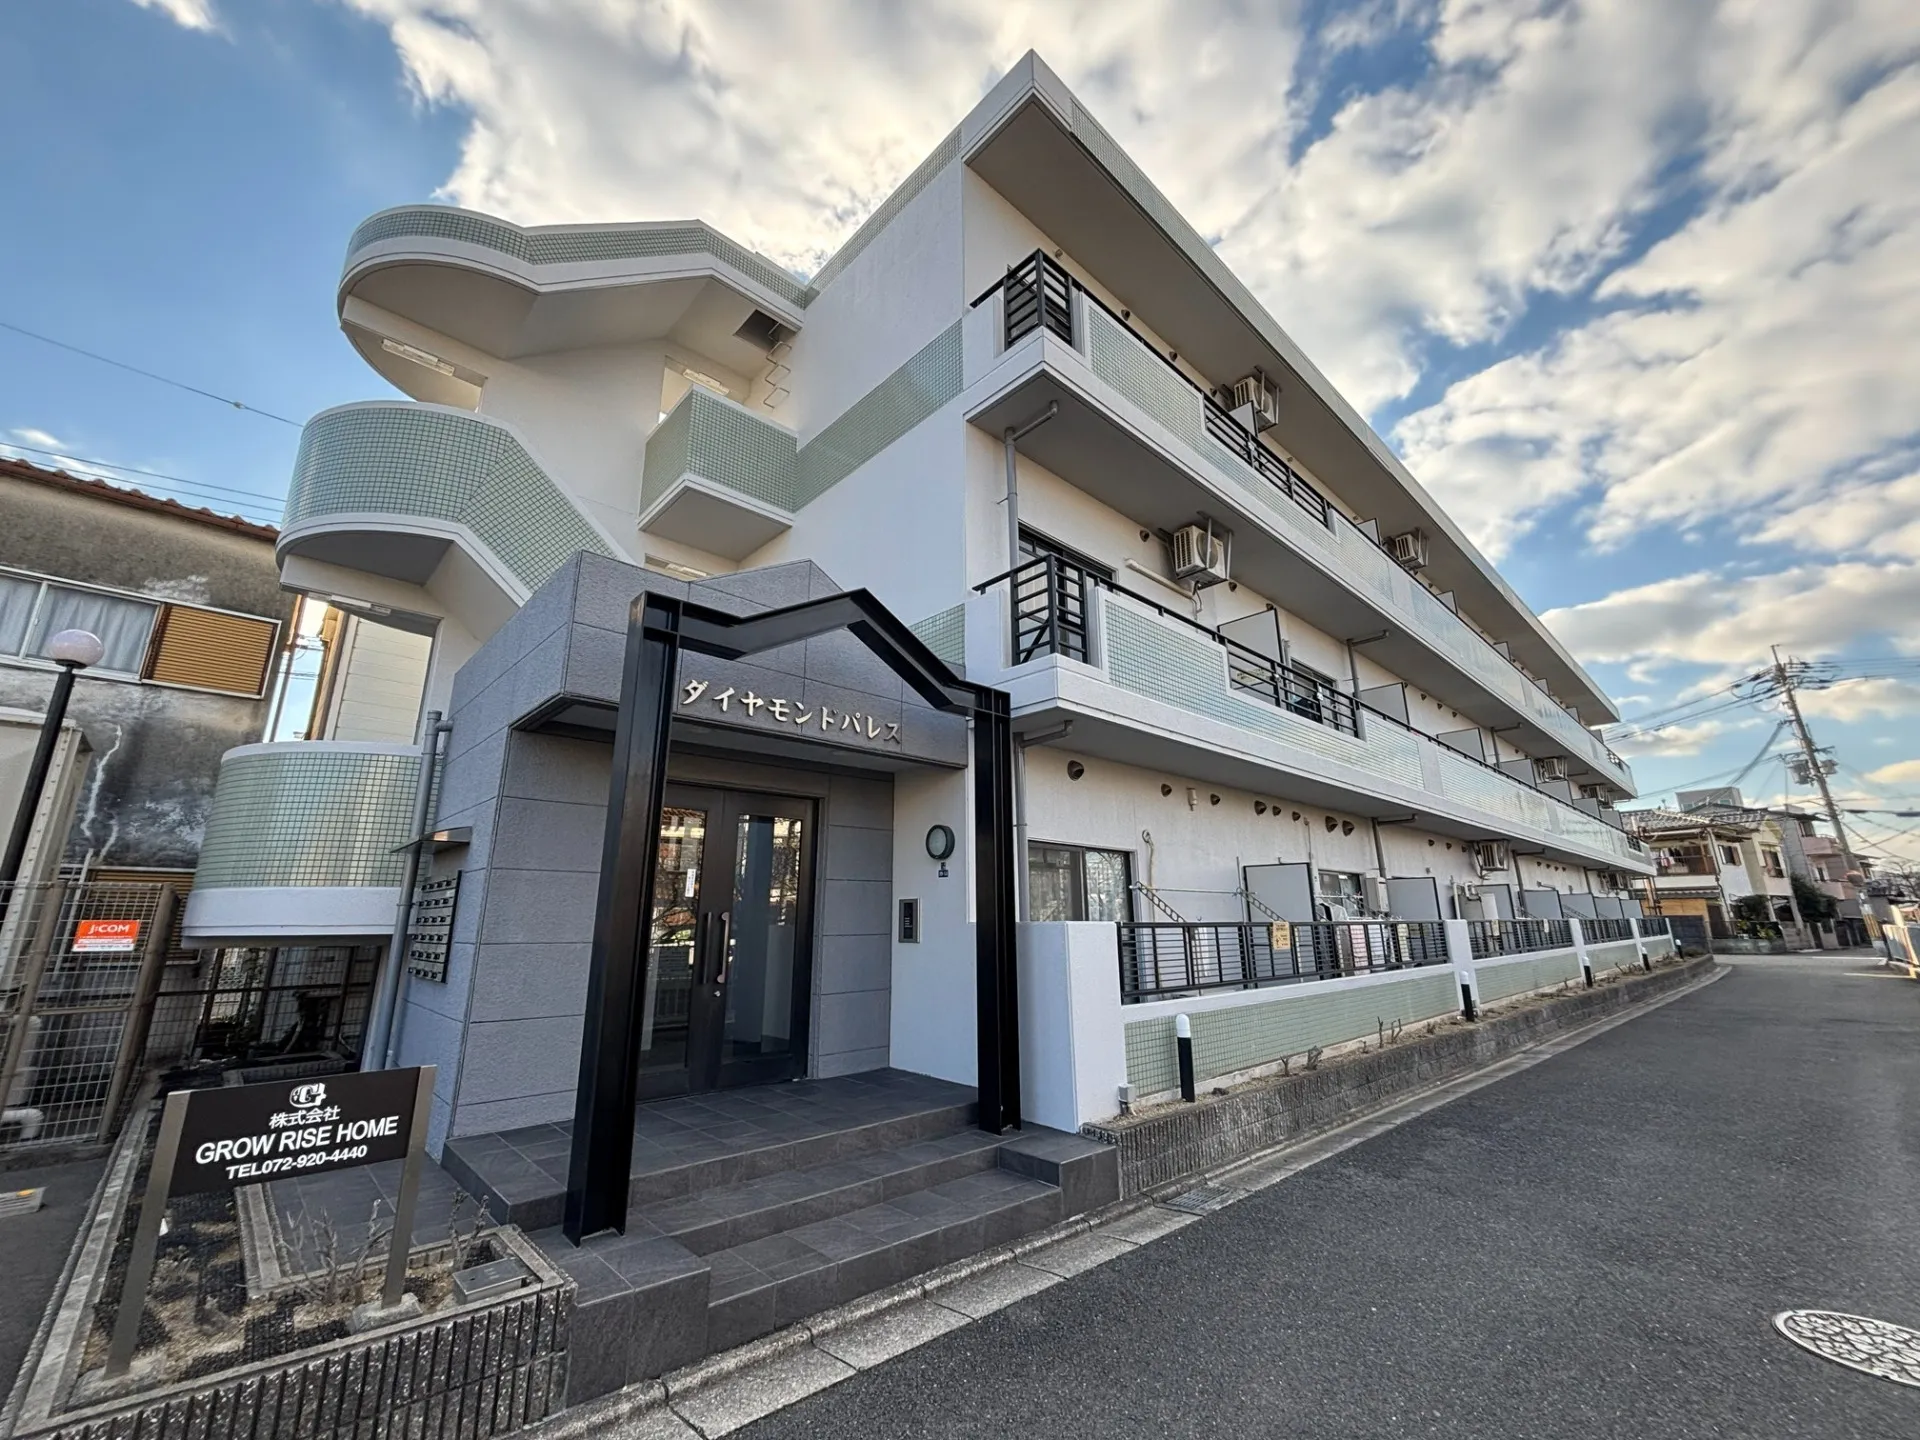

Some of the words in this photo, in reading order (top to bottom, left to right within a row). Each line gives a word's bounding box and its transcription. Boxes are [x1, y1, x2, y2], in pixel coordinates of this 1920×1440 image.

[682, 680, 901, 743] ダイヤモンドパレス
[269, 1105, 341, 1129] 株式会社
[195, 1134, 277, 1165] GROW
[278, 1125, 332, 1152] RISE
[336, 1116, 400, 1142] HOME
[226, 1145, 367, 1179] TEL072-920-4440
